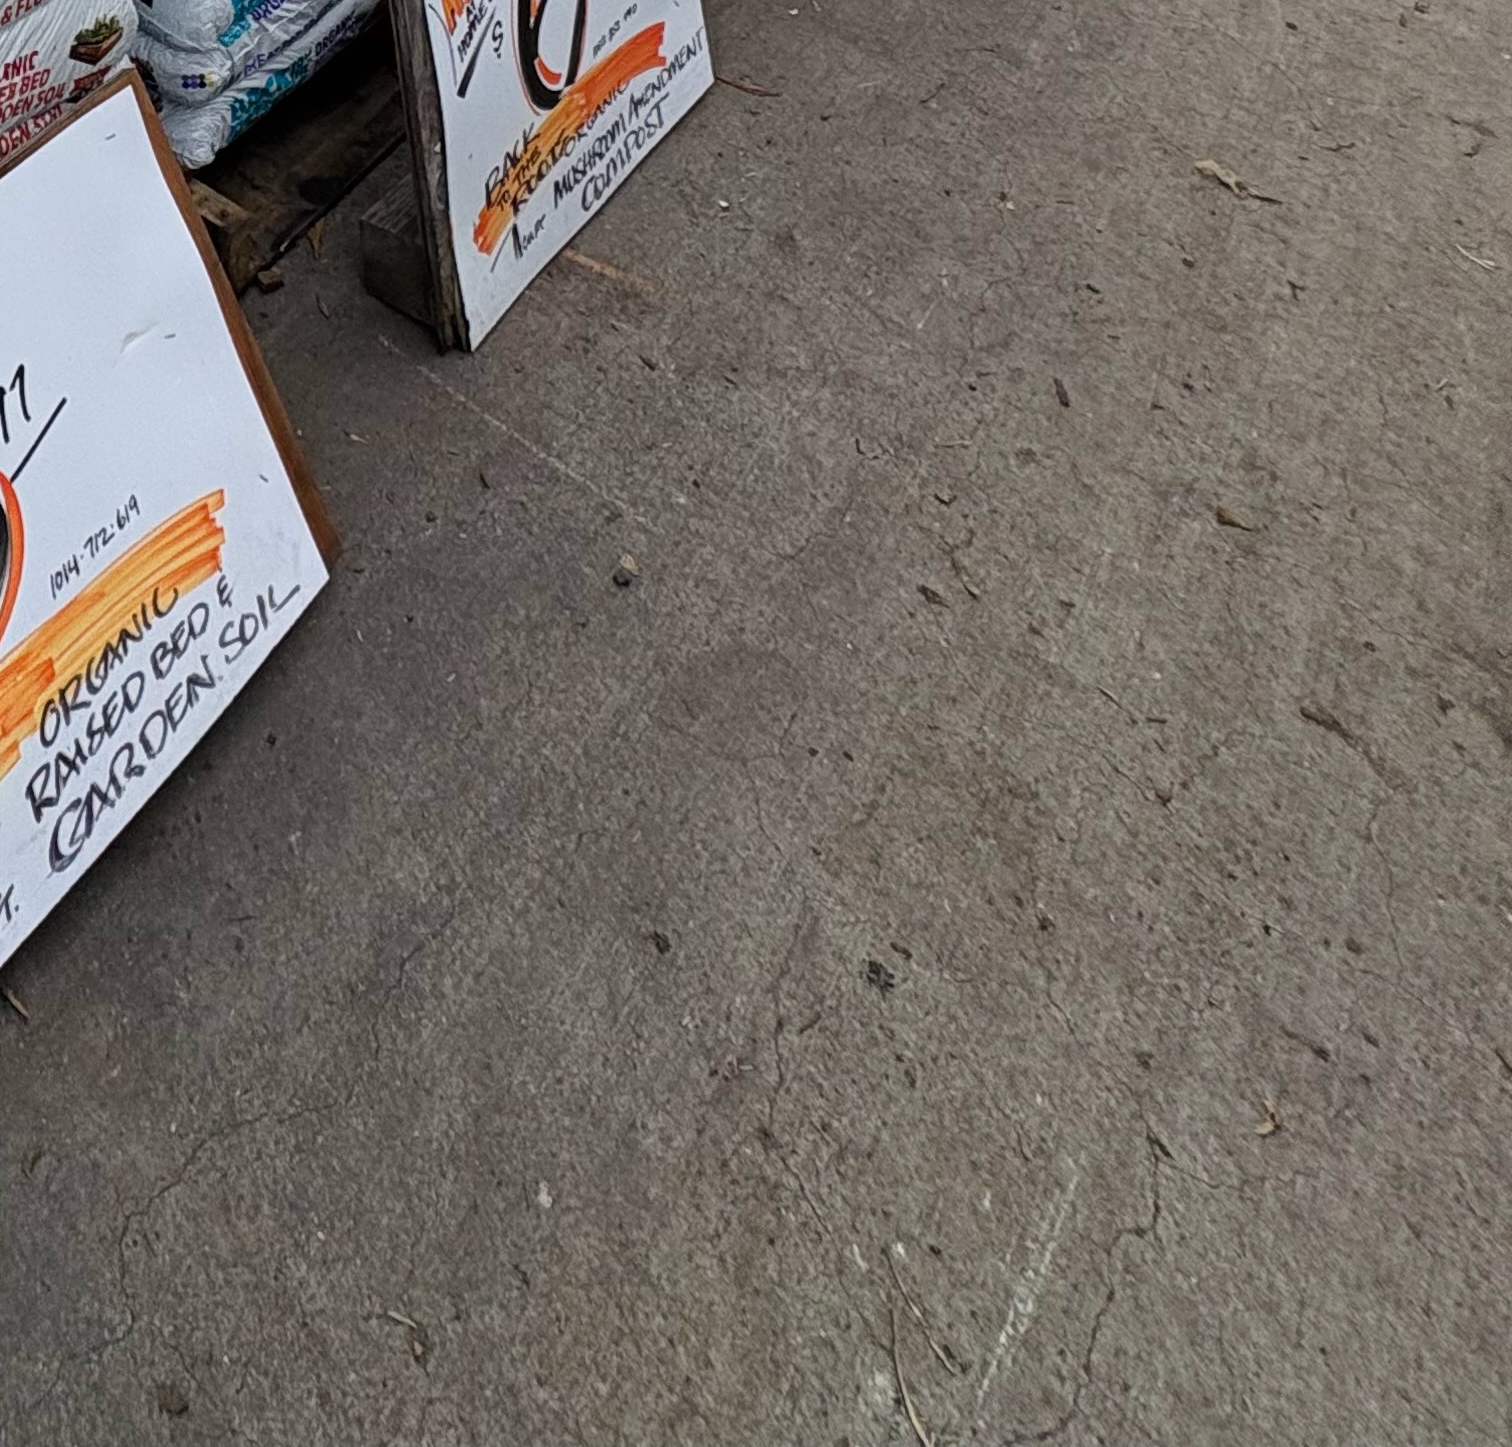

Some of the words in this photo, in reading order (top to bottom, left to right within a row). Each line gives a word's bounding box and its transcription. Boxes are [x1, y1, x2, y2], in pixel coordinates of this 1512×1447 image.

[459, 5, 490, 62] HOME
[485, 123, 541, 211] BACK
[515, 145, 541, 186] THE
[553, 115, 627, 208] MUSHROOM
[628, 27, 704, 125] AMENDMENT
[581, 92, 669, 211] COMPOST
[40, 587, 179, 749] ORGANIC
[218, 585, 301, 665] SOIL
[26, 677, 145, 822] RAISED
[152, 606, 209, 682] BED
